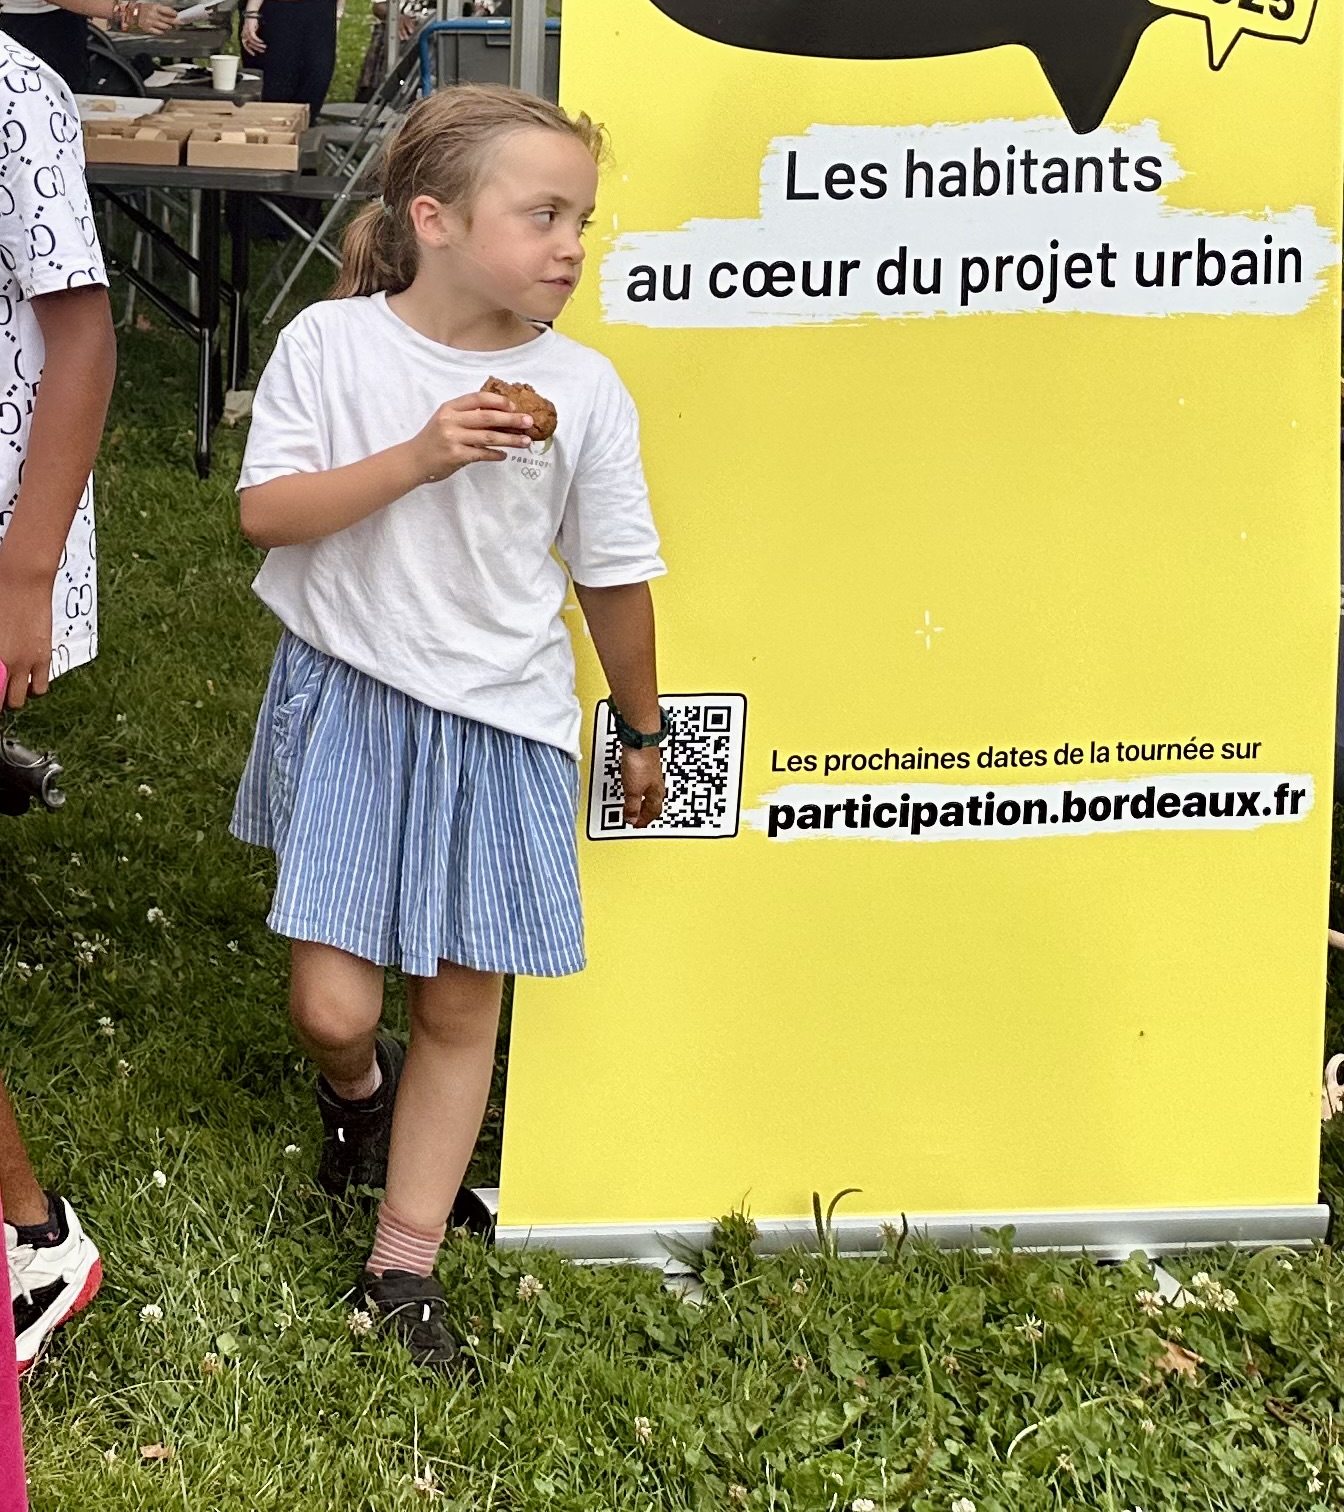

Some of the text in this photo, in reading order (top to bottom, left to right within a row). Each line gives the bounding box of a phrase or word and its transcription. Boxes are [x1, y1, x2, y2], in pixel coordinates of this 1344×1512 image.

[786, 145, 1163, 201] Les habitants
[626, 235, 1302, 307] au cœur du projet urbain
[772, 736, 1262, 777] Les prochaines dates de la tournée sur
[767, 783, 1306, 838] participation.bordeaux.fr
